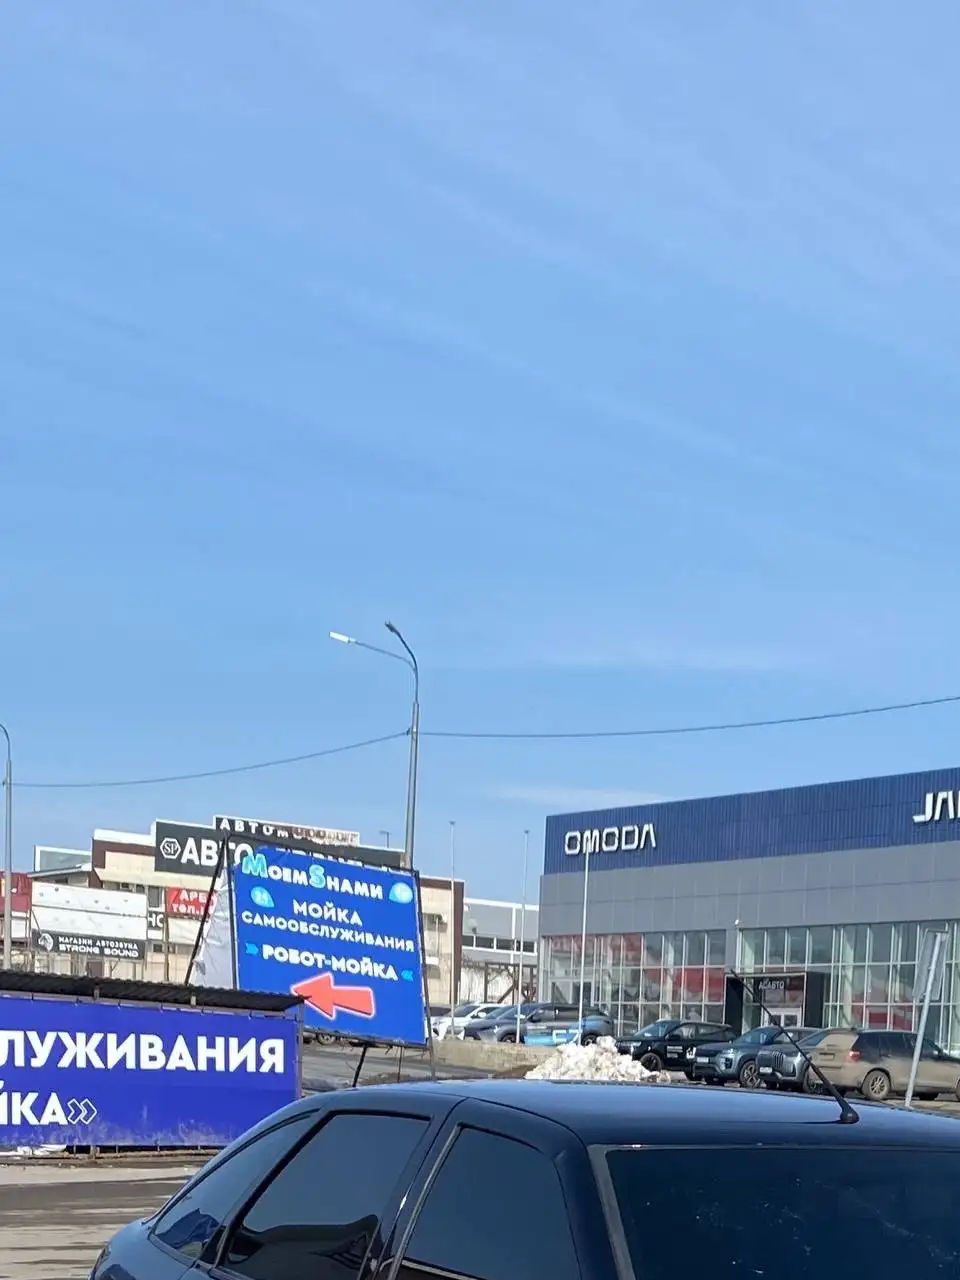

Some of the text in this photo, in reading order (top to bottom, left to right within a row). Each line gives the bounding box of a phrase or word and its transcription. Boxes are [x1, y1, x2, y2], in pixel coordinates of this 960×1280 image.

[564, 823, 656, 855] OMODA
[241, 910, 415, 953] САМООБСЛУЖИВАНИЯ
[292, 899, 363, 926] МОЙКА
[262, 943, 399, 981] РОБОТ-МОЙКА
[0, 1030, 284, 1074] ЛУЖИВАНИЯ
